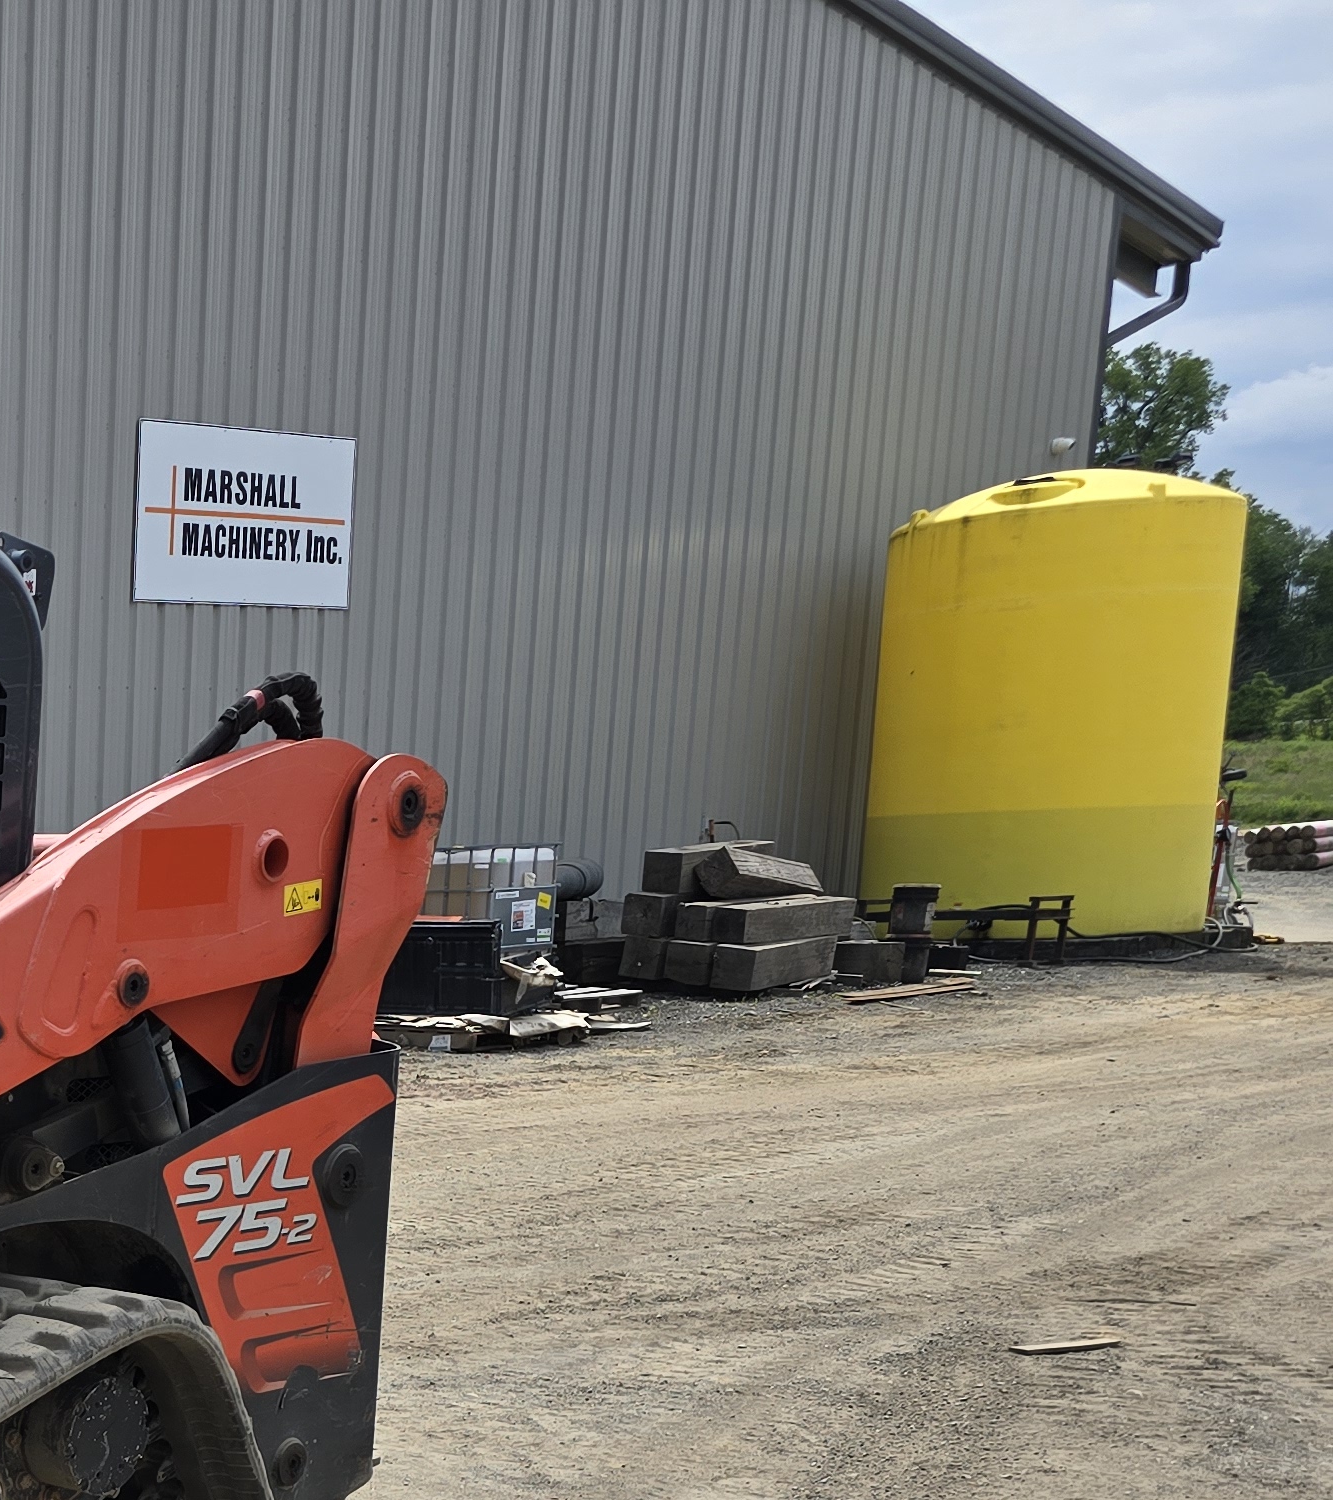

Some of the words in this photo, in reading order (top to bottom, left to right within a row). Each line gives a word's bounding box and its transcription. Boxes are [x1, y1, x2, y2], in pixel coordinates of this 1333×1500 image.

[184, 467, 301, 509] MARSHALL
[182, 523, 300, 563] MACHINERY,
[306, 529, 342, 564] Inc.
[175, 1147, 309, 1207] SVL
[193, 1198, 317, 1261] 75-2
